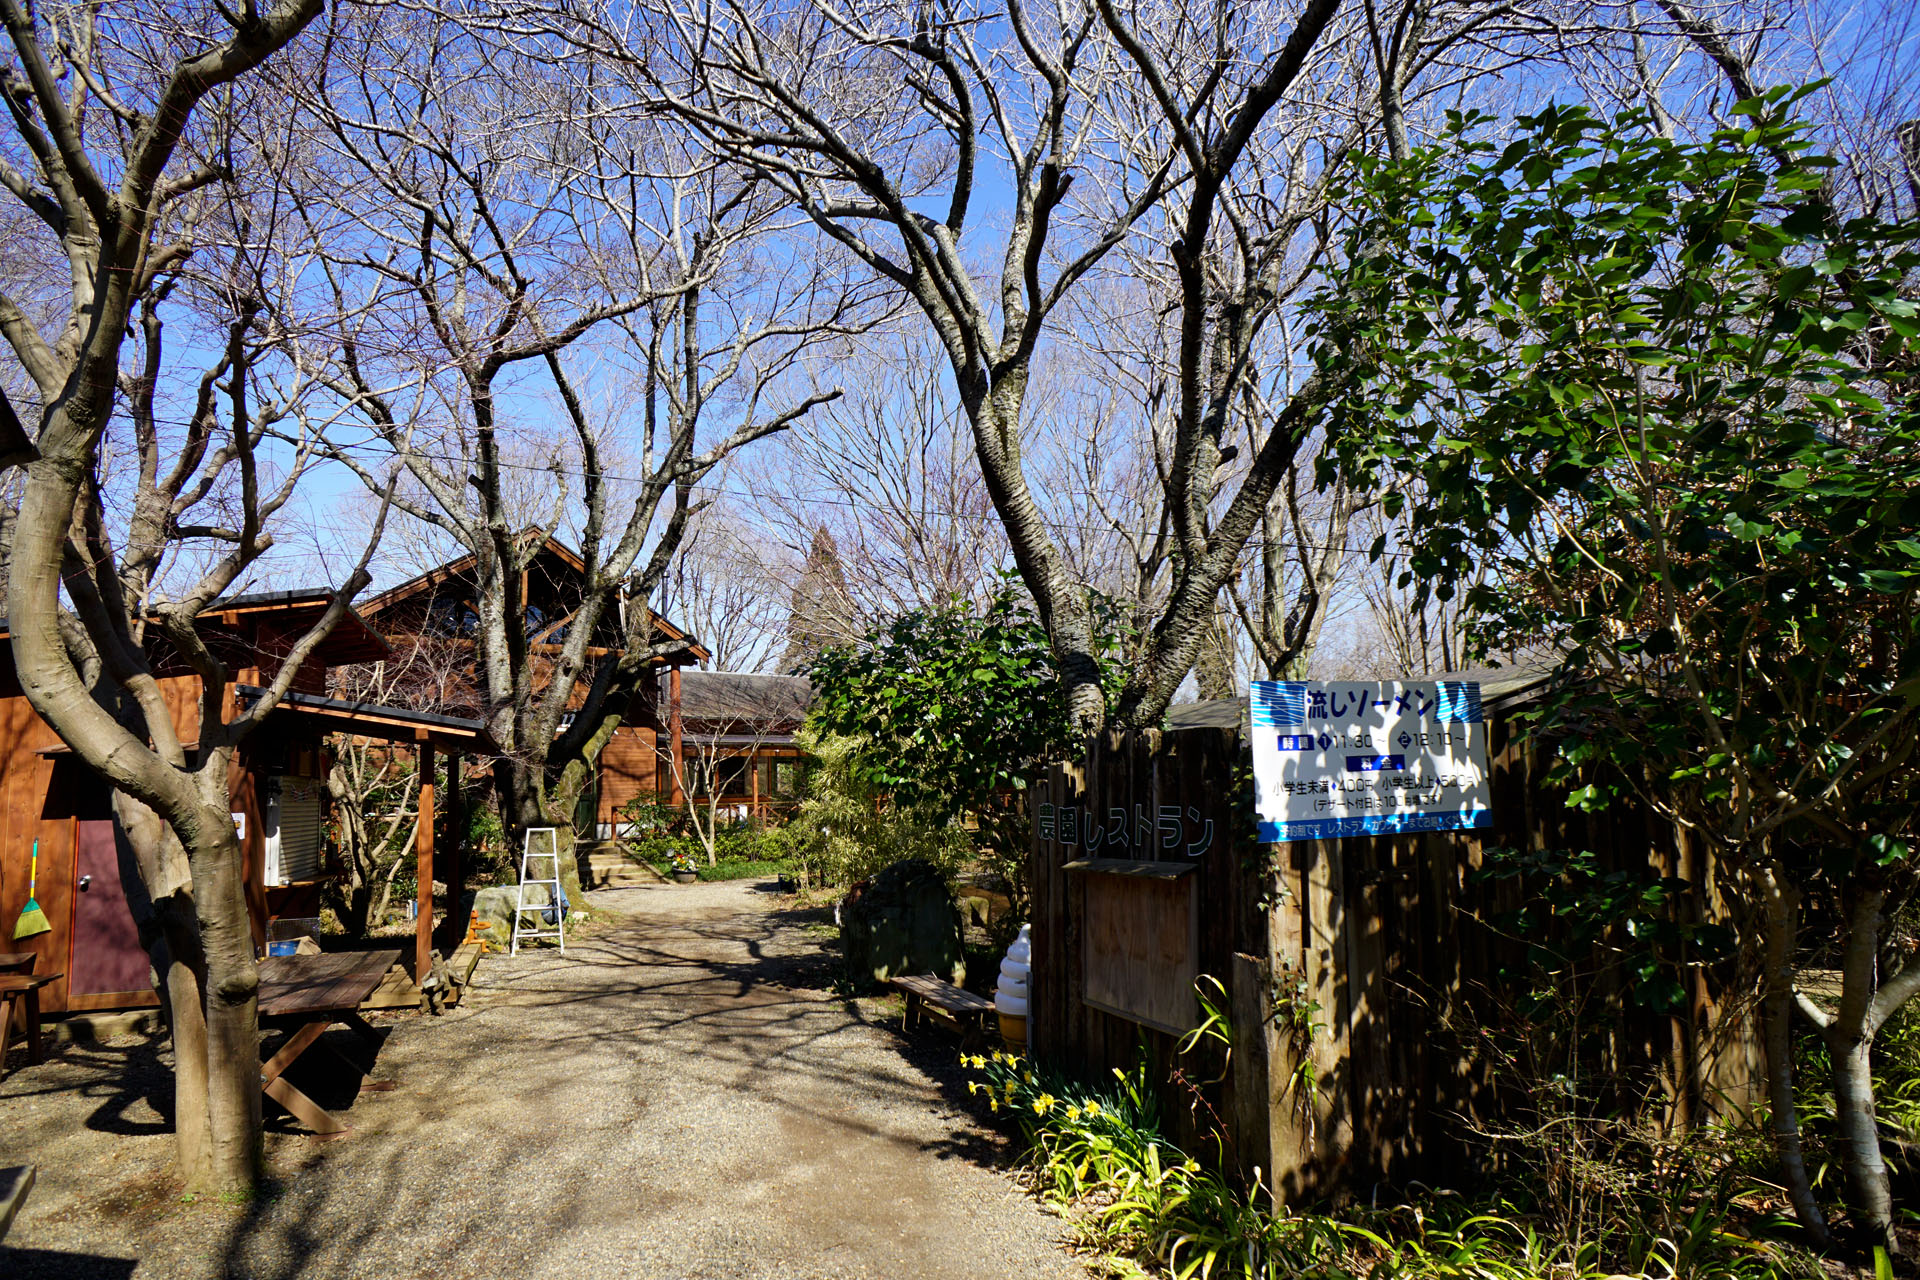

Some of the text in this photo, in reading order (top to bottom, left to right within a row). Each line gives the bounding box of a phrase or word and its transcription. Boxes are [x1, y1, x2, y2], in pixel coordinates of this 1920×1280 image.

[1307, 689, 1434, 719] 流しソーメン
[1282, 737, 1309, 750] 時間
[1361, 756, 1392, 769] 料金
[1037, 802, 1214, 857] 農園レストラン
